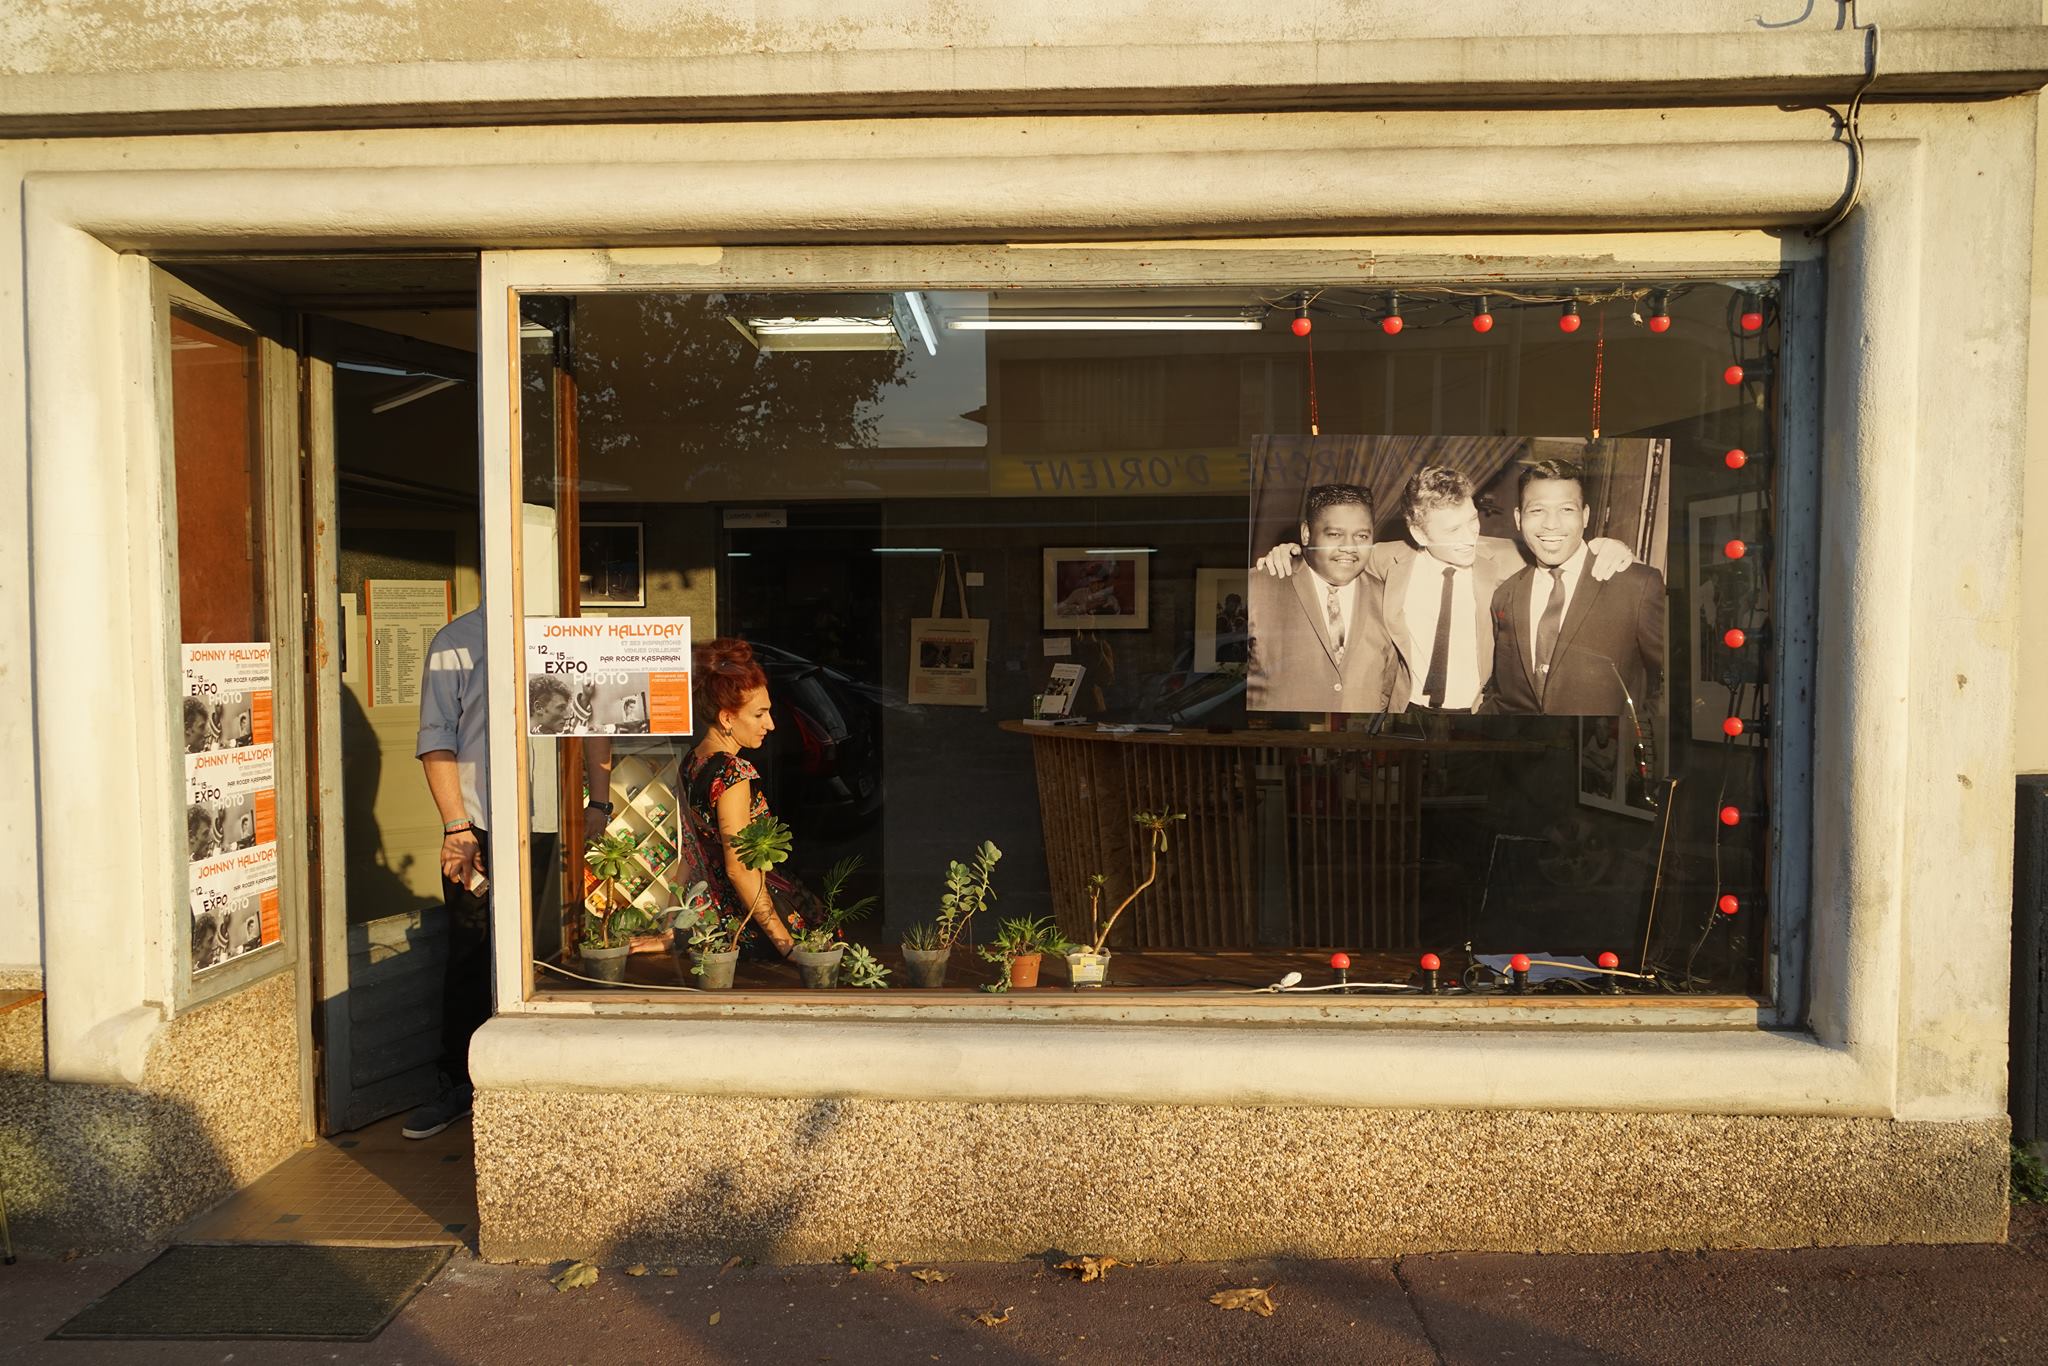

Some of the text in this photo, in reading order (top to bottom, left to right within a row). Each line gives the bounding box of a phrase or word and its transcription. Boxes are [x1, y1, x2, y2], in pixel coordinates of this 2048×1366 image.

[543, 623, 685, 639] JOHNNY HALLYDAY
[190, 649, 271, 663] JOHNNY HALLYDAY
[537, 644, 548, 655] 12
[556, 651, 566, 661] 15
[599, 655, 614, 663] PAR
[641, 655, 681, 663] KASPARIAN
[186, 669, 194, 678] 12
[545, 661, 588, 674] EXPO
[197, 675, 204, 683] 15
[573, 672, 628, 686] PHOTO
[191, 683, 218, 696] EXPO
[208, 692, 243, 706] PHOTO
[195, 754, 229, 769] JOHNNY
[231, 749, 273, 765] HALLYDAY
[194, 788, 221, 804] EXPO
[211, 794, 245, 811] PHOTO
[198, 859, 235, 879] JOHNNY
[237, 847, 277, 869] HALLYDAY
[195, 886, 203, 896] 12
[203, 894, 228, 913] EXPO
